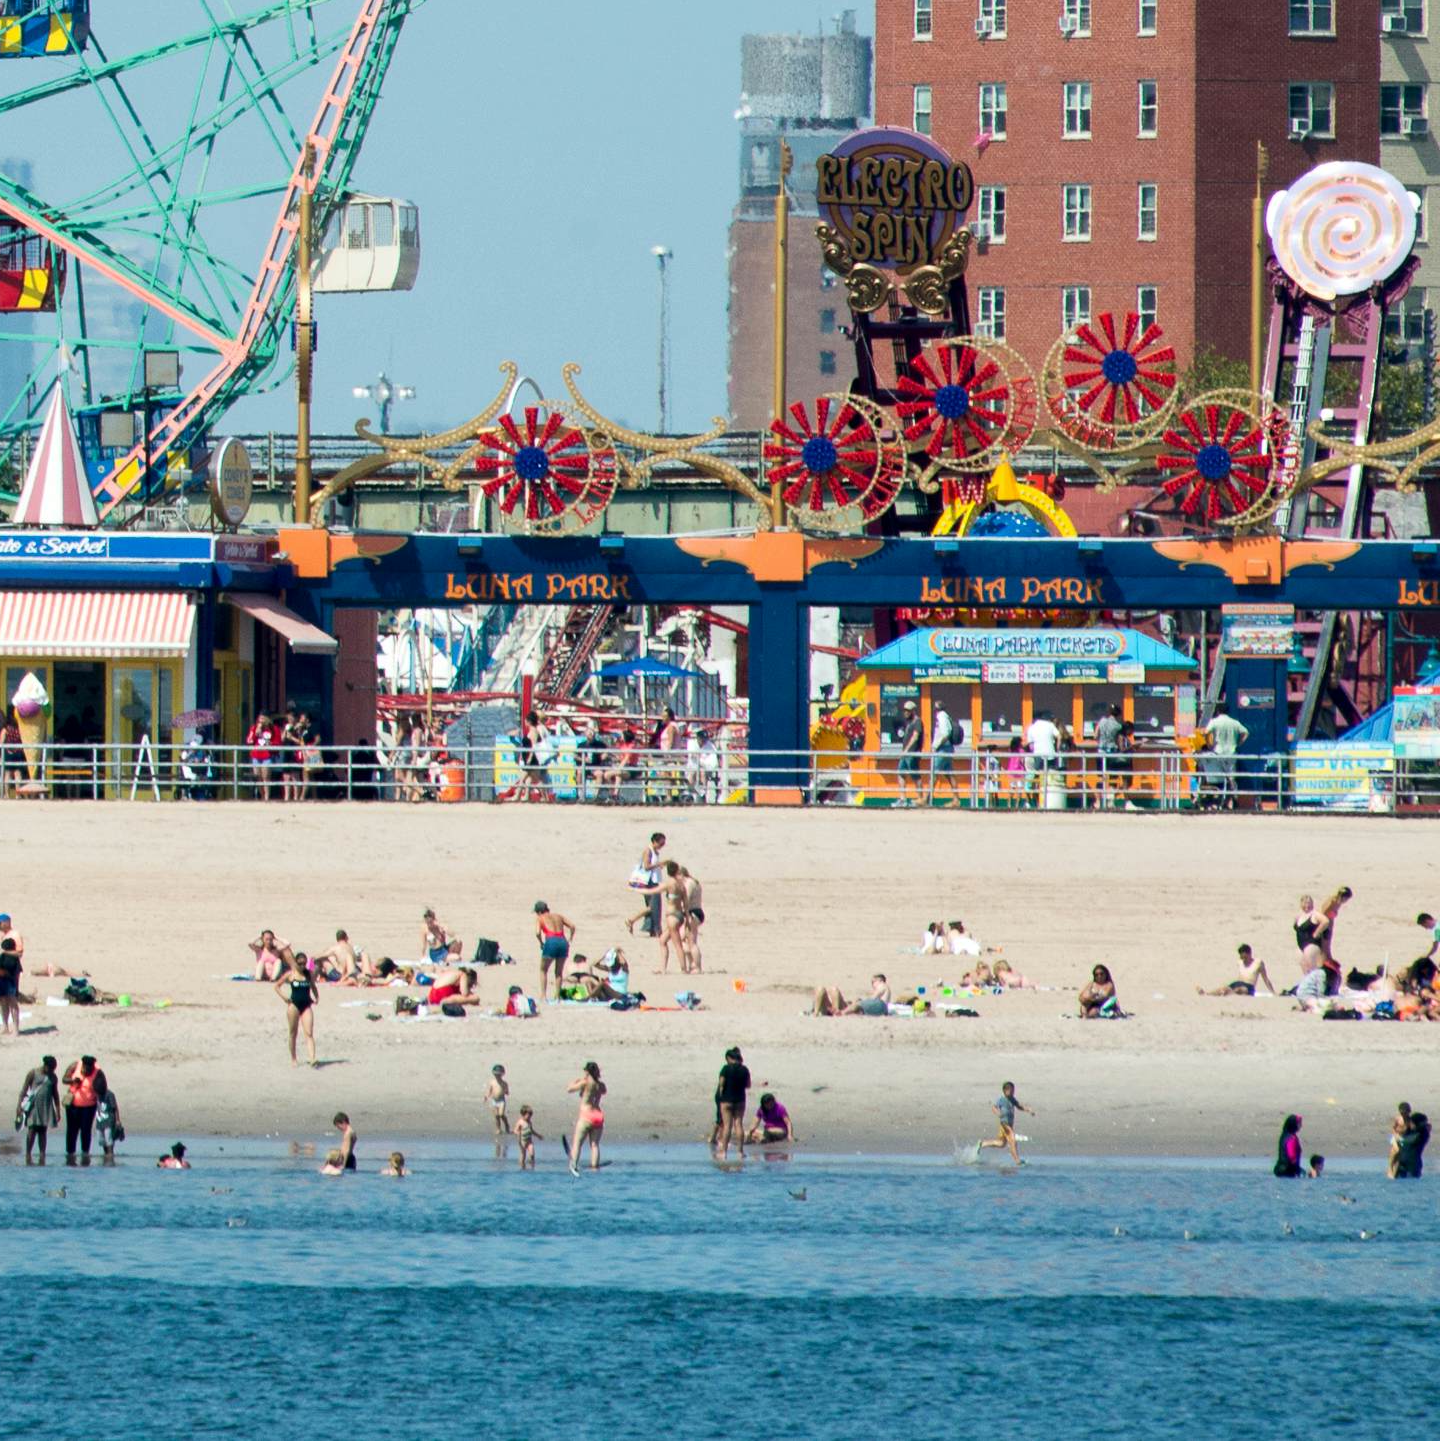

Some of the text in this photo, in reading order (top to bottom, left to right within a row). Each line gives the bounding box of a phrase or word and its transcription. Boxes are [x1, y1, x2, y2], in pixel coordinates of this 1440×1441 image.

[816, 154, 974, 211] ELECTRO
[850, 211, 931, 263] SPIN
[24, 540, 38, 554] &
[39, 536, 107, 555] Sorbet
[445, 573, 632, 600] LUNA PARK
[921, 576, 1105, 604] LUNA PARK
[942, 634, 1117, 654] LUNA PARK TICKETS
